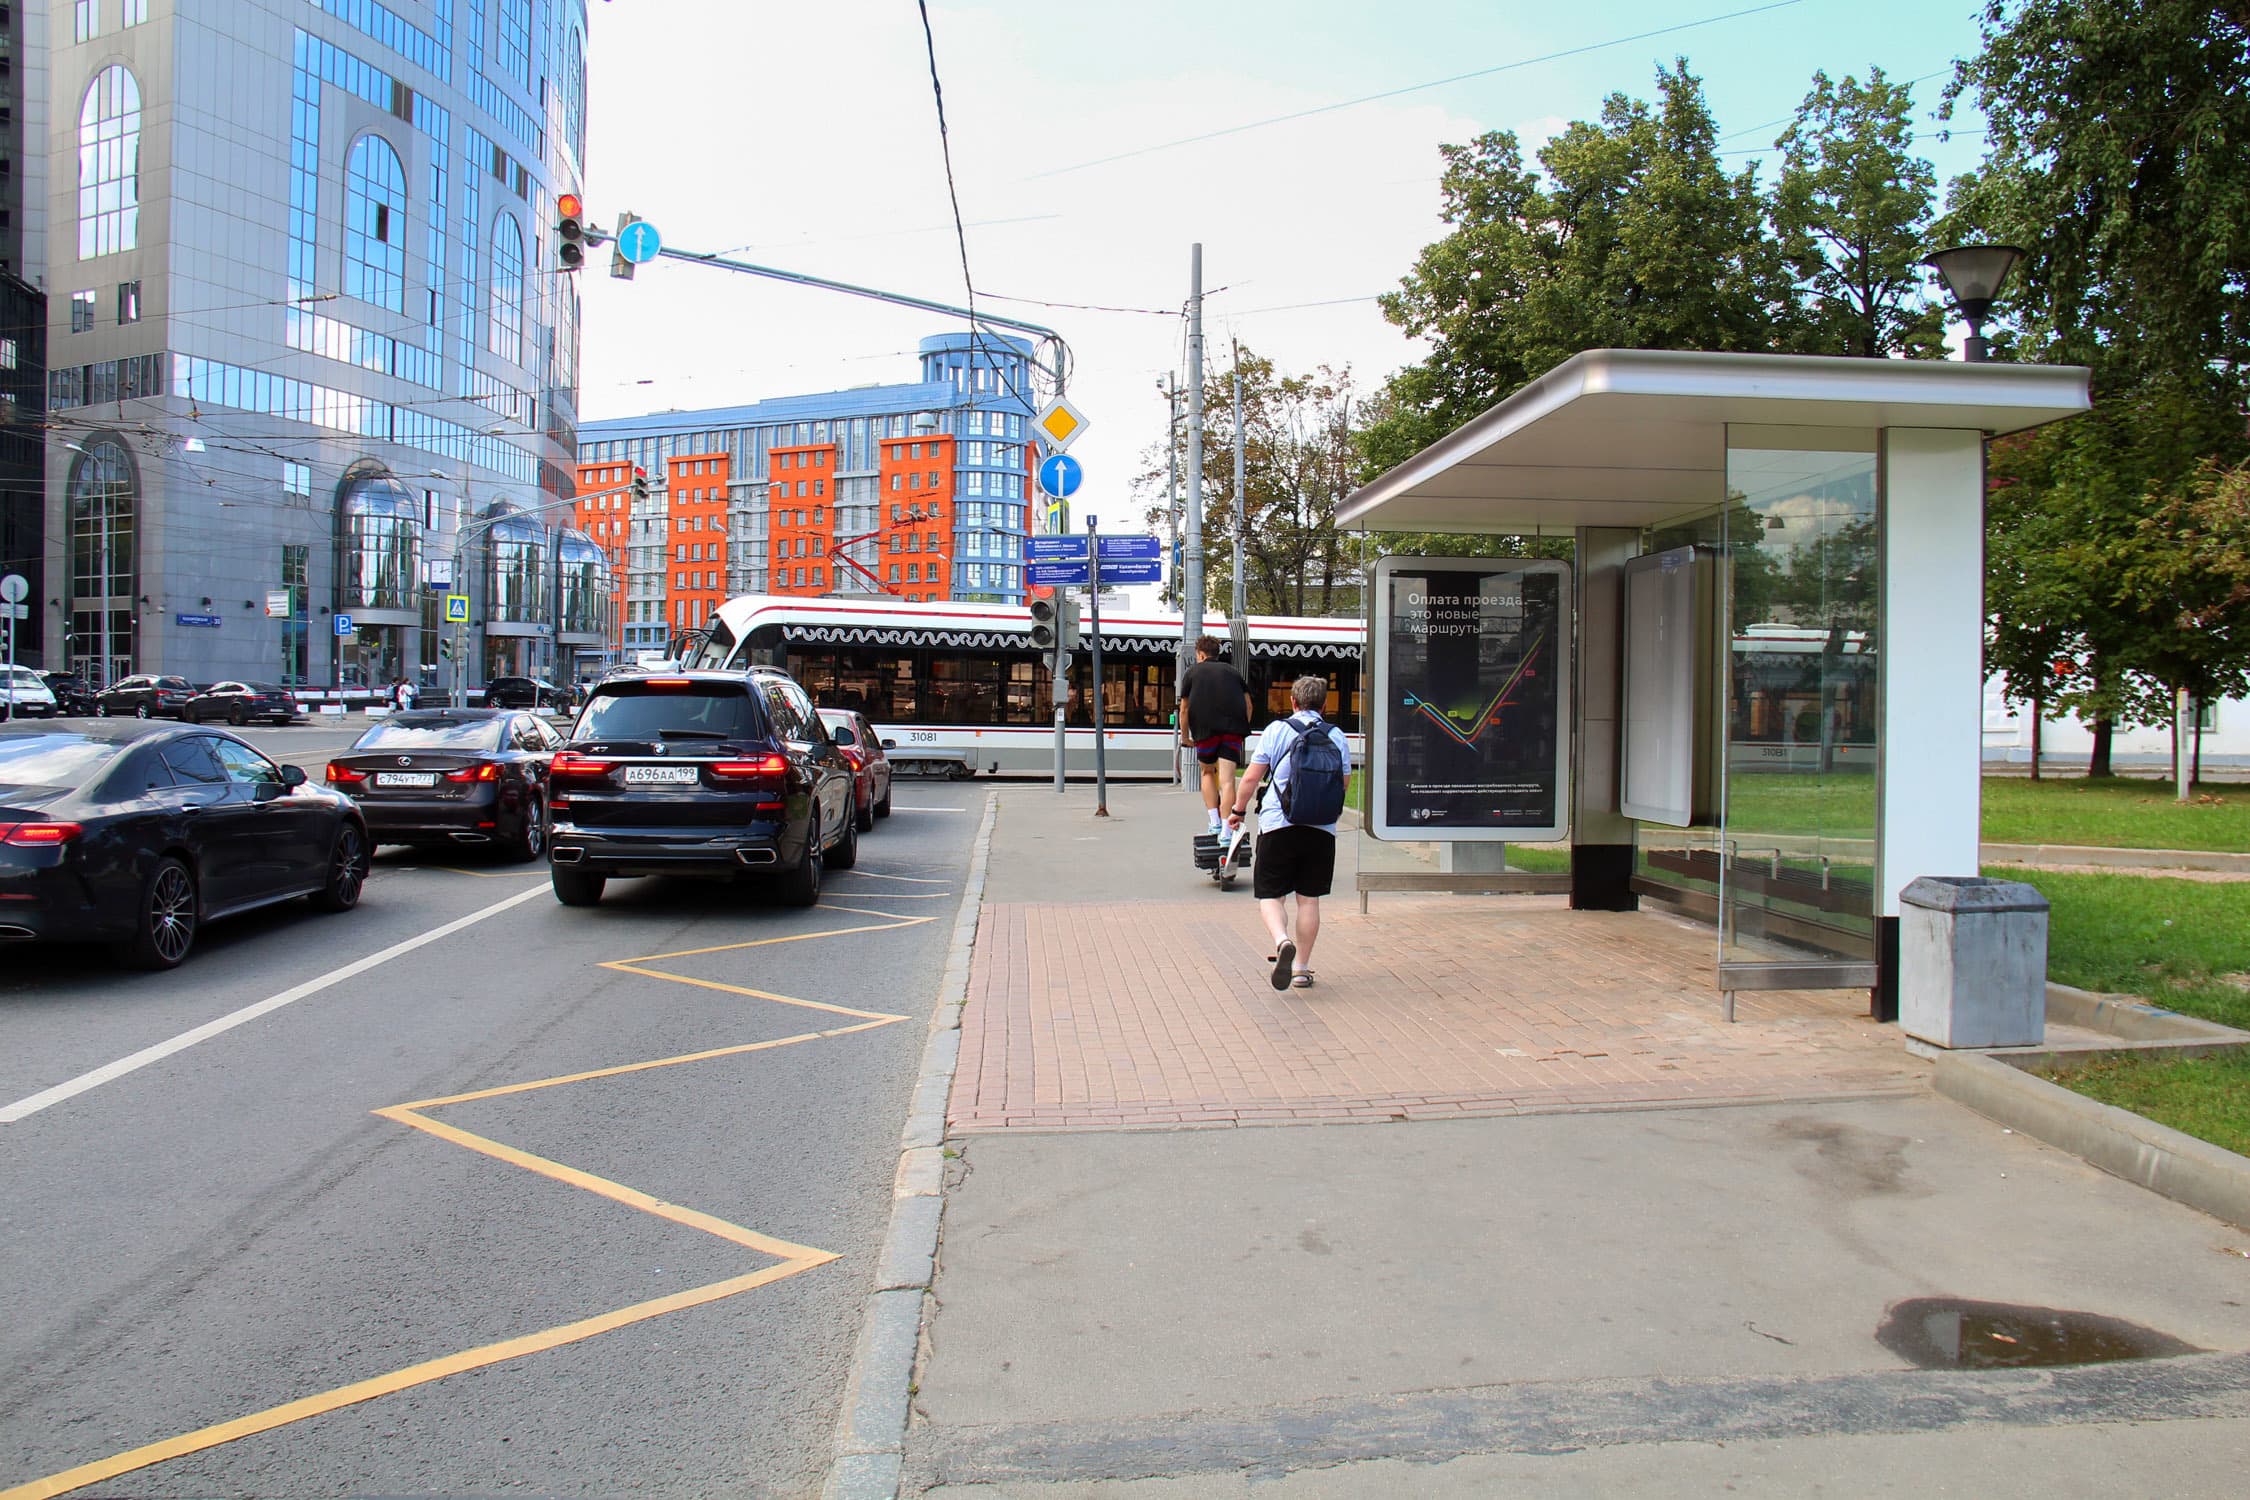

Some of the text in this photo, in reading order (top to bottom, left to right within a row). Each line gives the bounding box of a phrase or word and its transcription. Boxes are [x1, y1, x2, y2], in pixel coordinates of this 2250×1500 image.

[1408, 593, 1459, 606] Оплата
[1463, 595, 1522, 608] проезда
[1410, 610, 1480, 620] это новые
[910, 732, 936, 742] 31081
